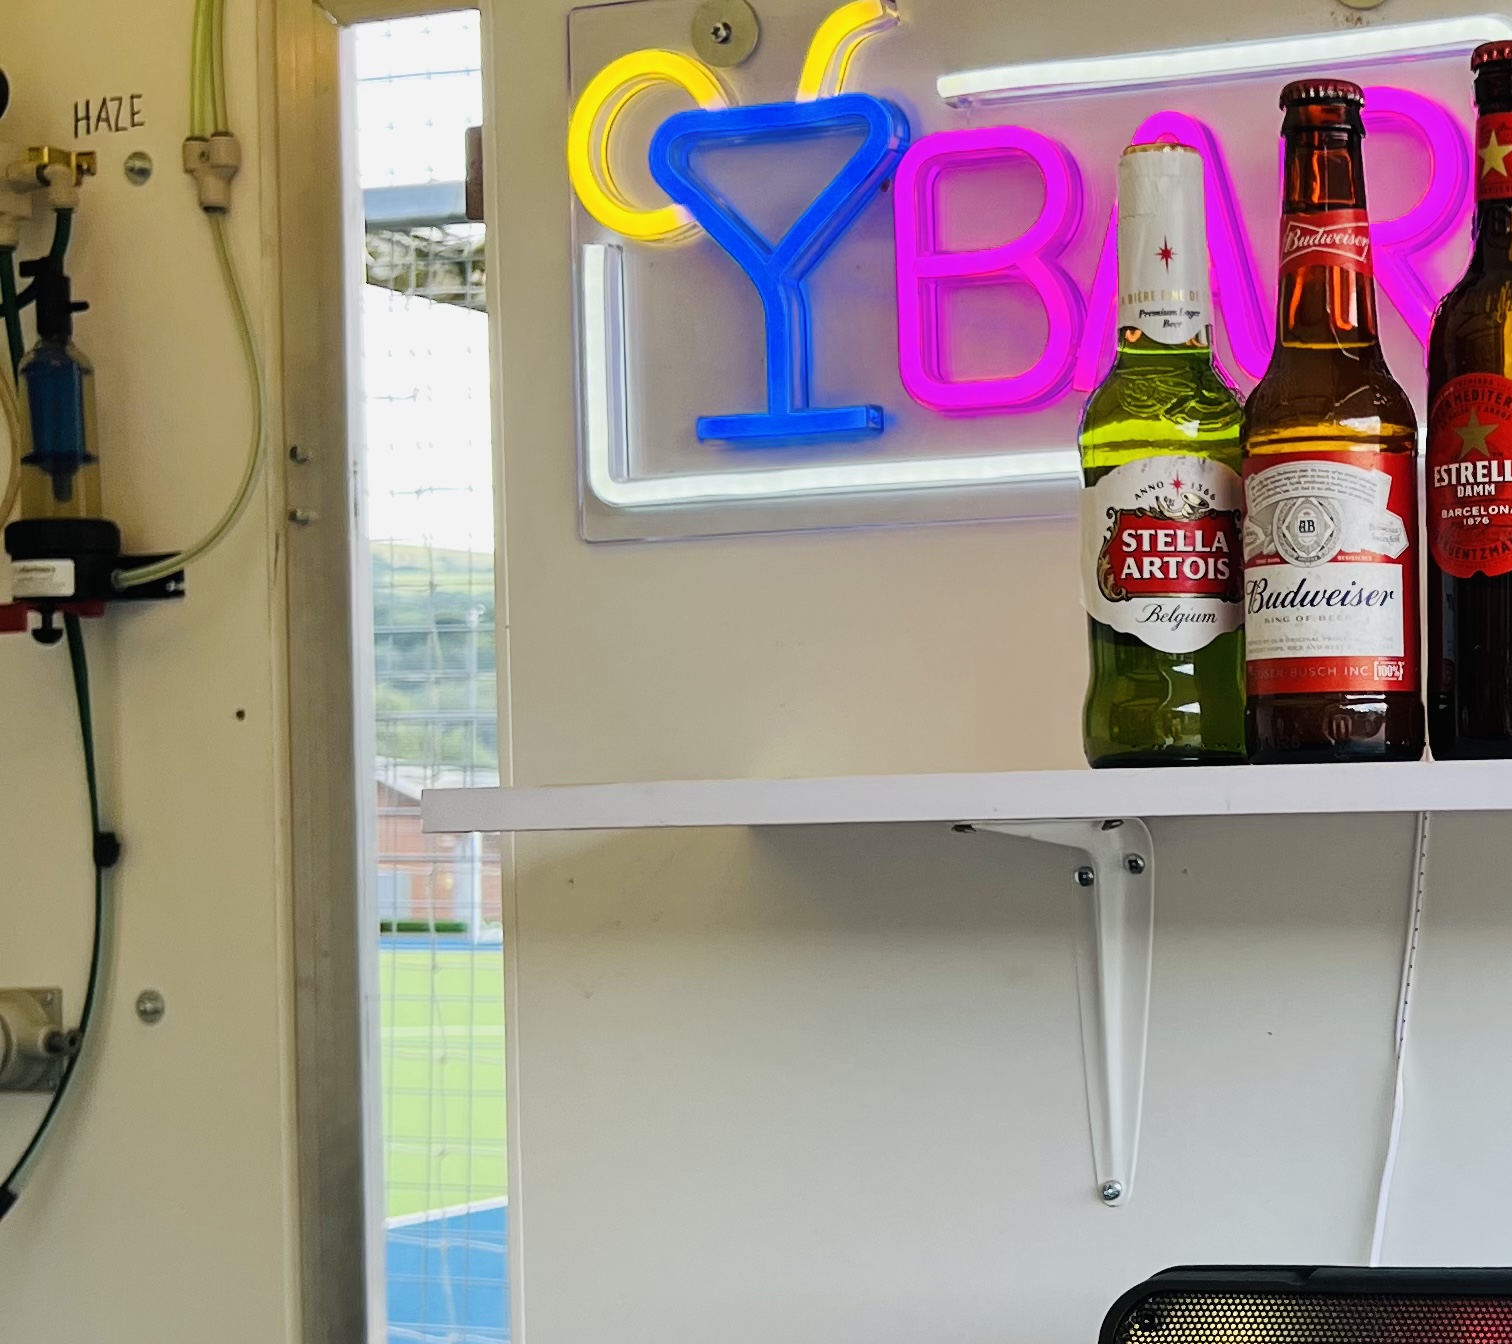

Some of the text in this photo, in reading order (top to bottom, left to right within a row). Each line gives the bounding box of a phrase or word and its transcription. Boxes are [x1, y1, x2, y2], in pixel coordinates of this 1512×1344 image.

[73, 93, 146, 139] HAZE
[1283, 226, 1370, 254] Budweiser
[1134, 481, 1165, 501] ANNO
[1457, 482, 1496, 498] DAMM
[1463, 516, 1490, 526] 1876
[1122, 529, 1229, 553] STELLA
[1121, 557, 1230, 579] ARTOIS
[1246, 577, 1395, 615] Budweiser
[1135, 602, 1218, 631] Belgium
[1290, 667, 1337, 678] BUSCH
[1344, 666, 1369, 676] INC
